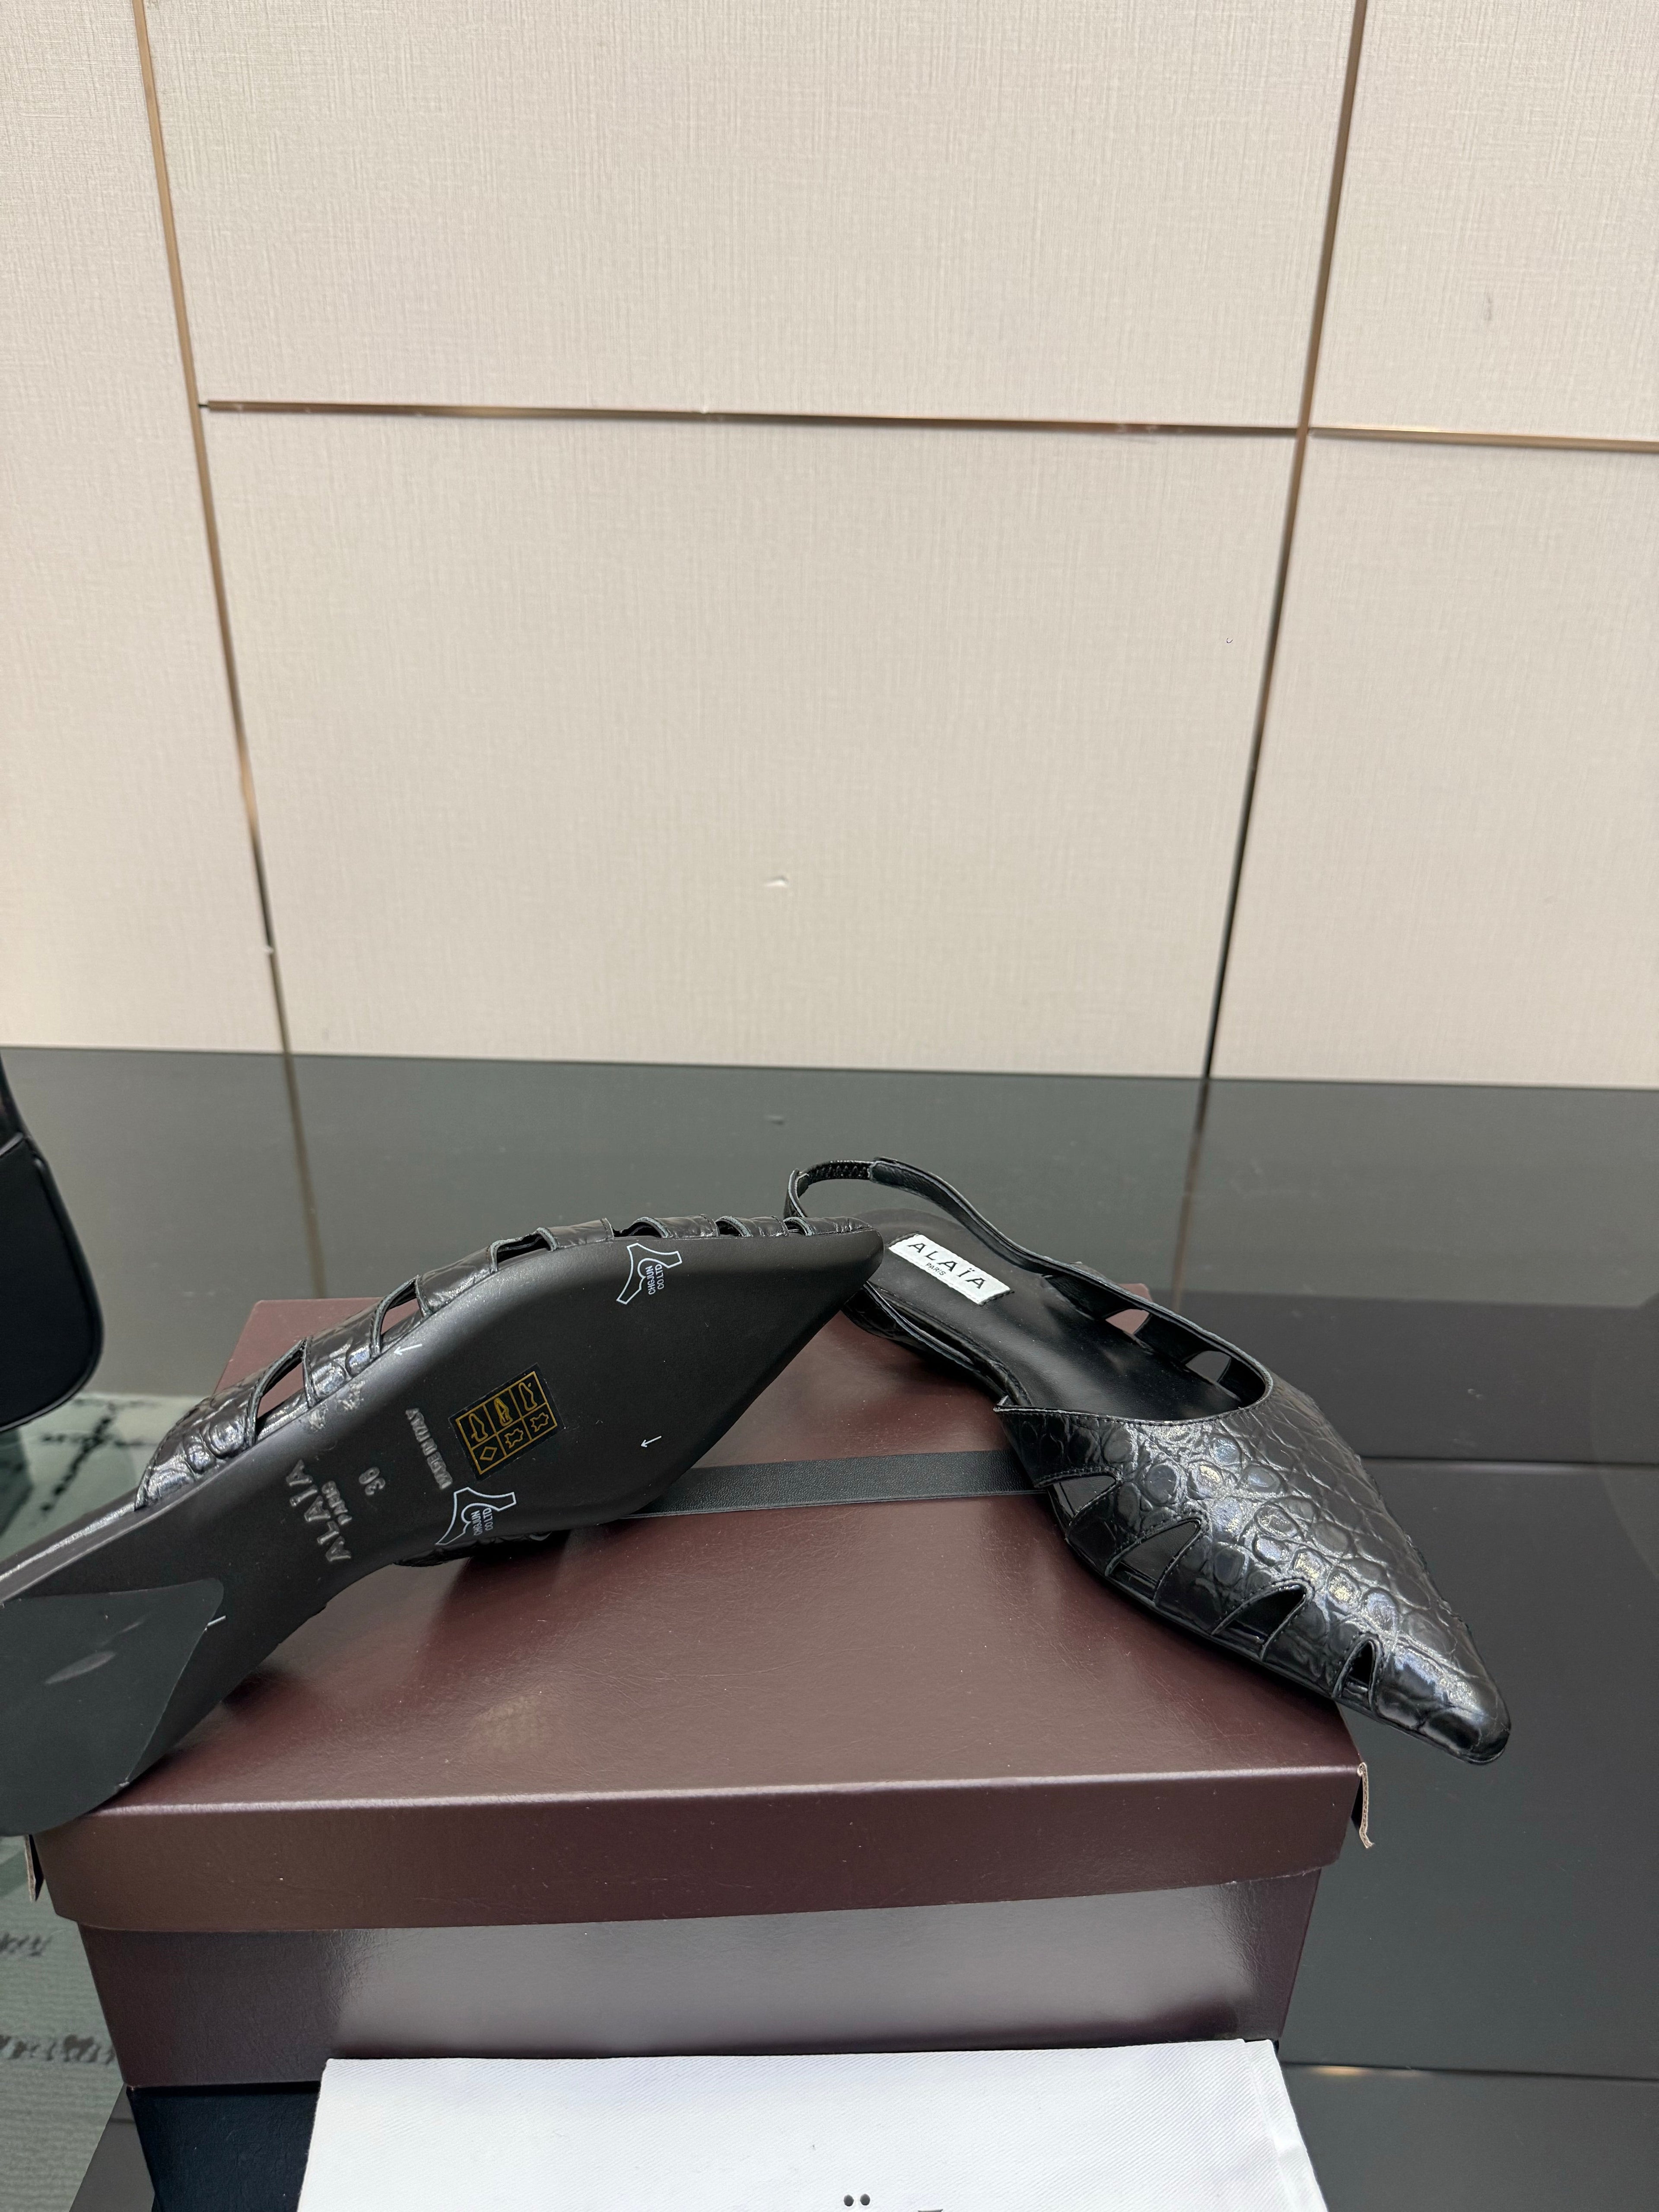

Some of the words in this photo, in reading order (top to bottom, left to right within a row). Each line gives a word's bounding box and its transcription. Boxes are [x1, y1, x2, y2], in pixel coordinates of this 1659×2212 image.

[645, 1265, 656, 1295] CHGJUN
[907, 1243, 986, 1289] ALAÏA
[925, 1262, 946, 1276] PARIS
[421, 1438, 437, 1456] IN
[359, 1467, 385, 1495] 36
[286, 1459, 351, 1562] ALAÏA
[322, 1481, 352, 1525] PARIS
